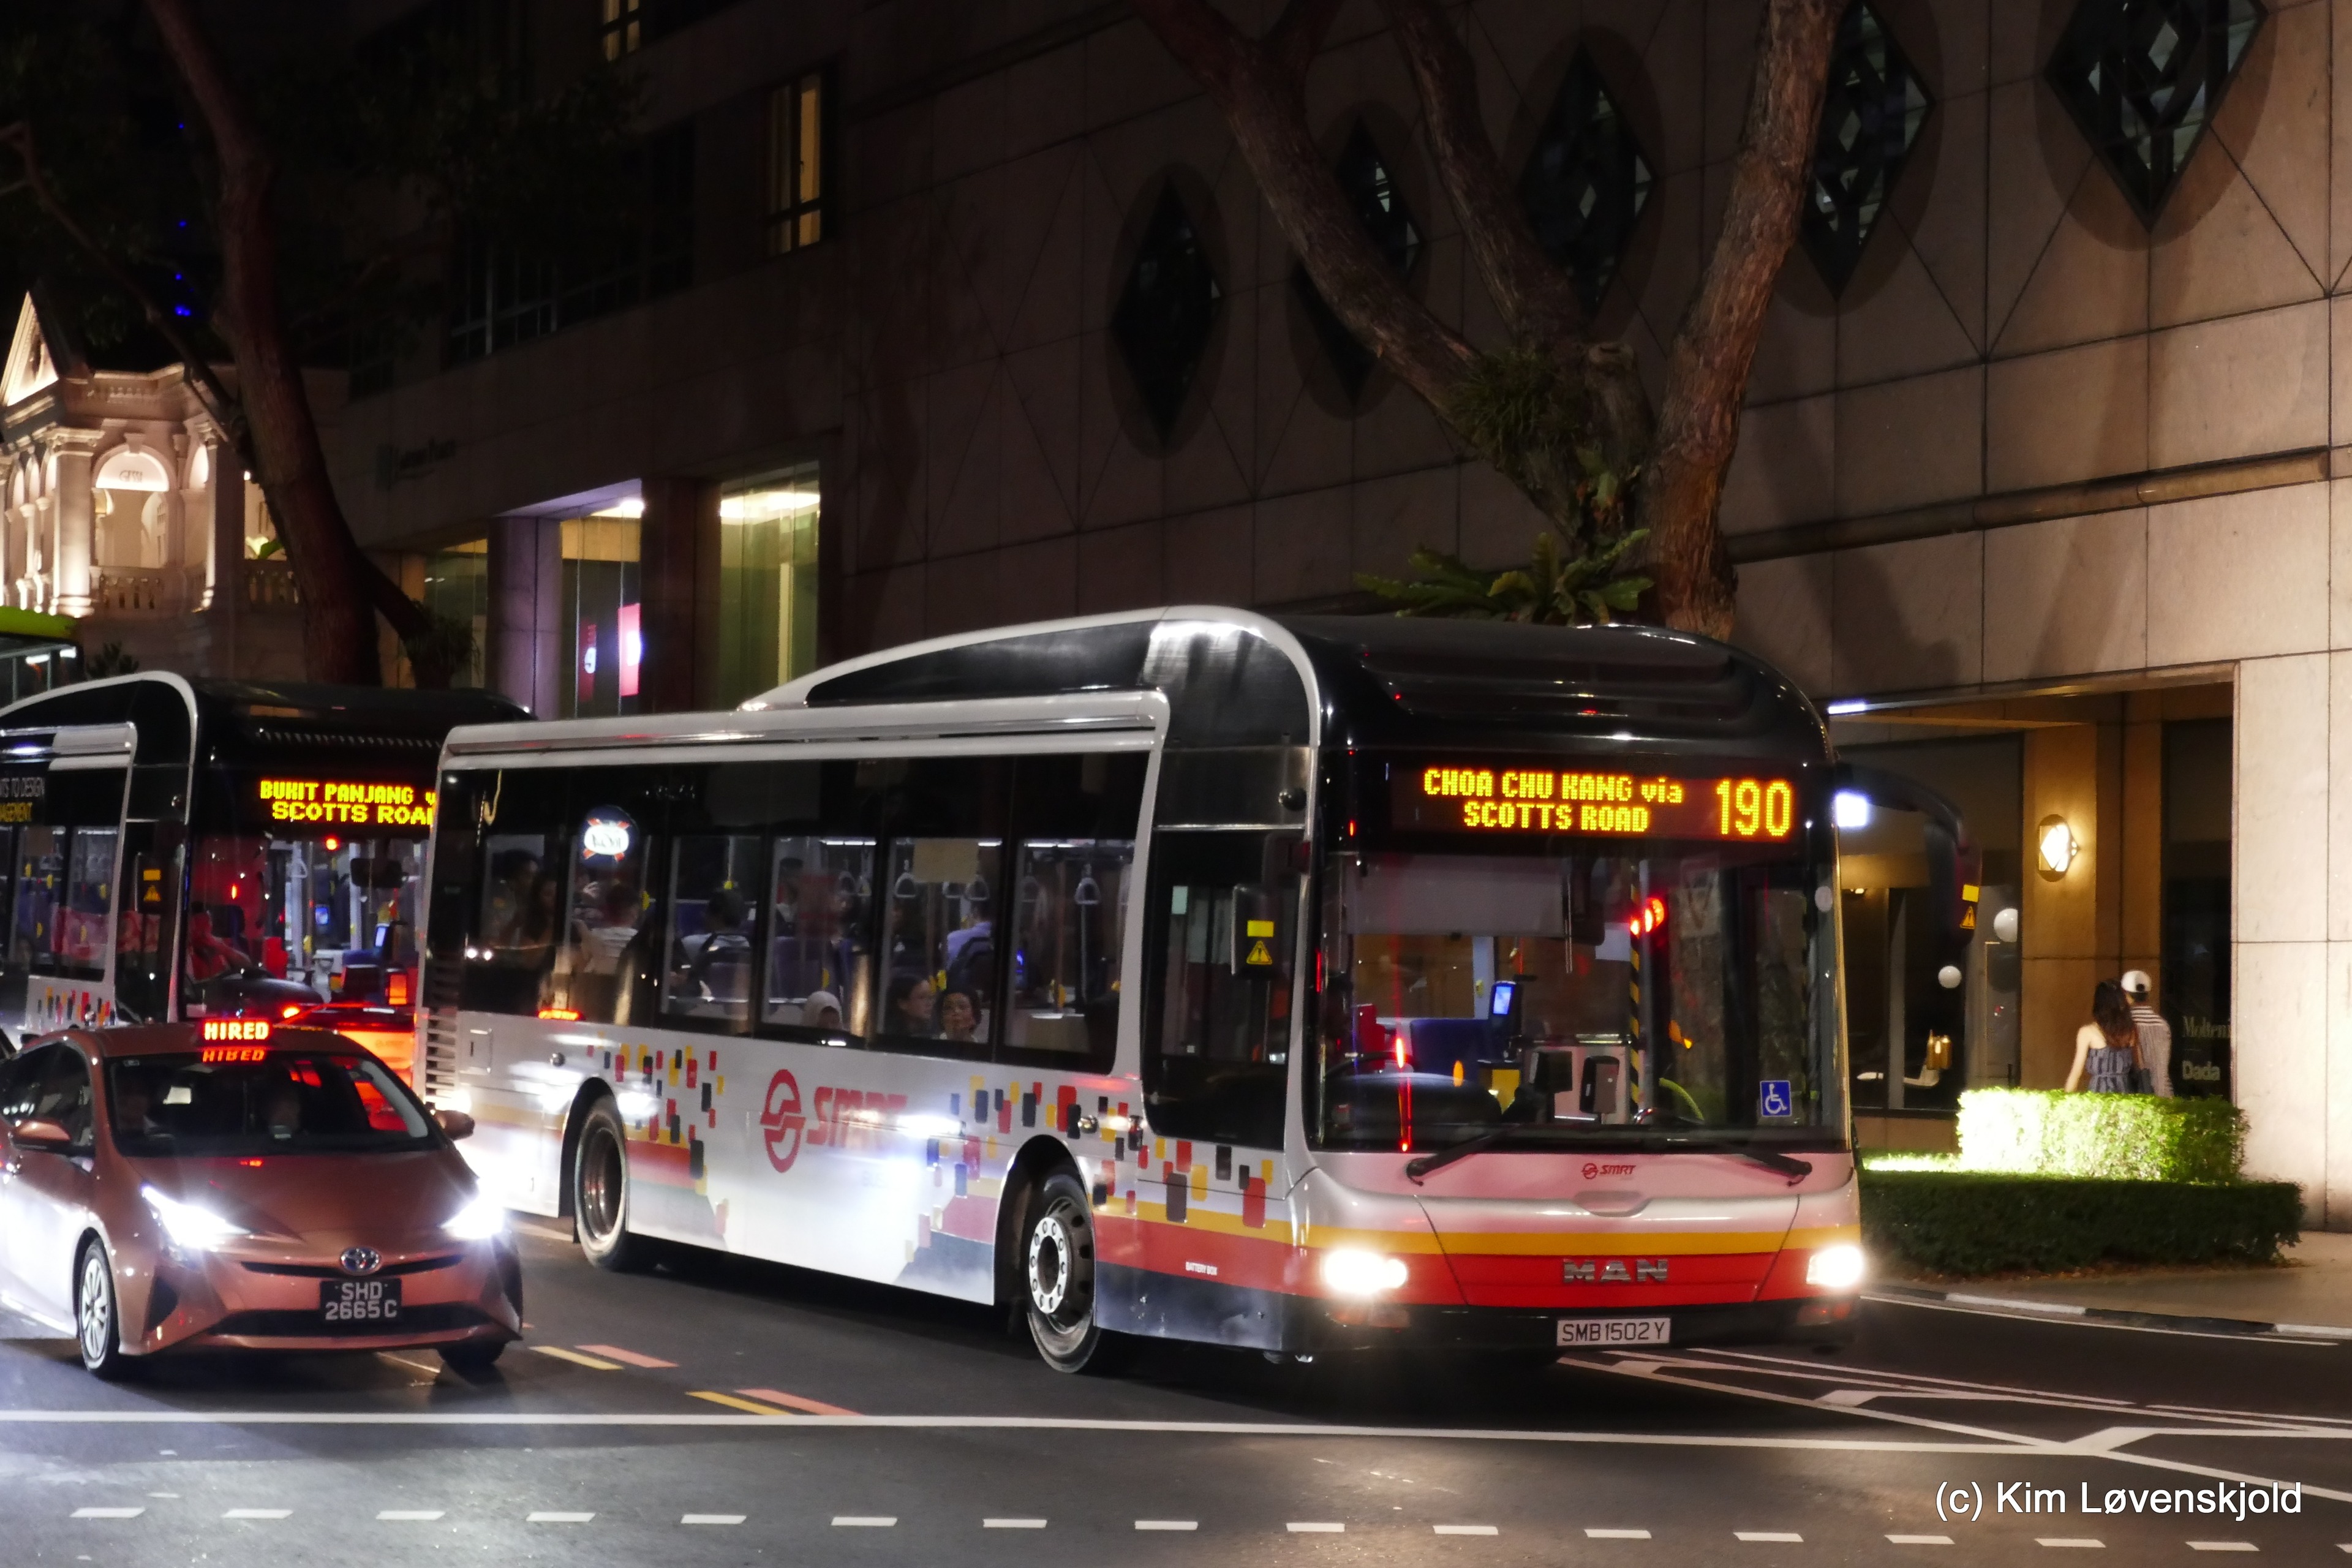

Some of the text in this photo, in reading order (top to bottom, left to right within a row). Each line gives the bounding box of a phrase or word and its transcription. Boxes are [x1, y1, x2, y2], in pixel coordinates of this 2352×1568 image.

[260, 780, 319, 801] BUKIT
[325, 783, 413, 805] PANJANG
[1424, 769, 1683, 803] CHOA CHU KANG via
[272, 801, 368, 823] SCOTTS
[1463, 802, 1649, 832] SCOTTS ROAD
[1716, 779, 1791, 837] 190
[204, 1022, 270, 1041] HIRED
[2182, 1060, 2221, 1081] Dada
[1599, 1164, 1637, 1175] SMRT
[1563, 1258, 1668, 1283] MAN
[341, 1281, 383, 1301] SHD
[1562, 1322, 1665, 1342] SMB1502Y
